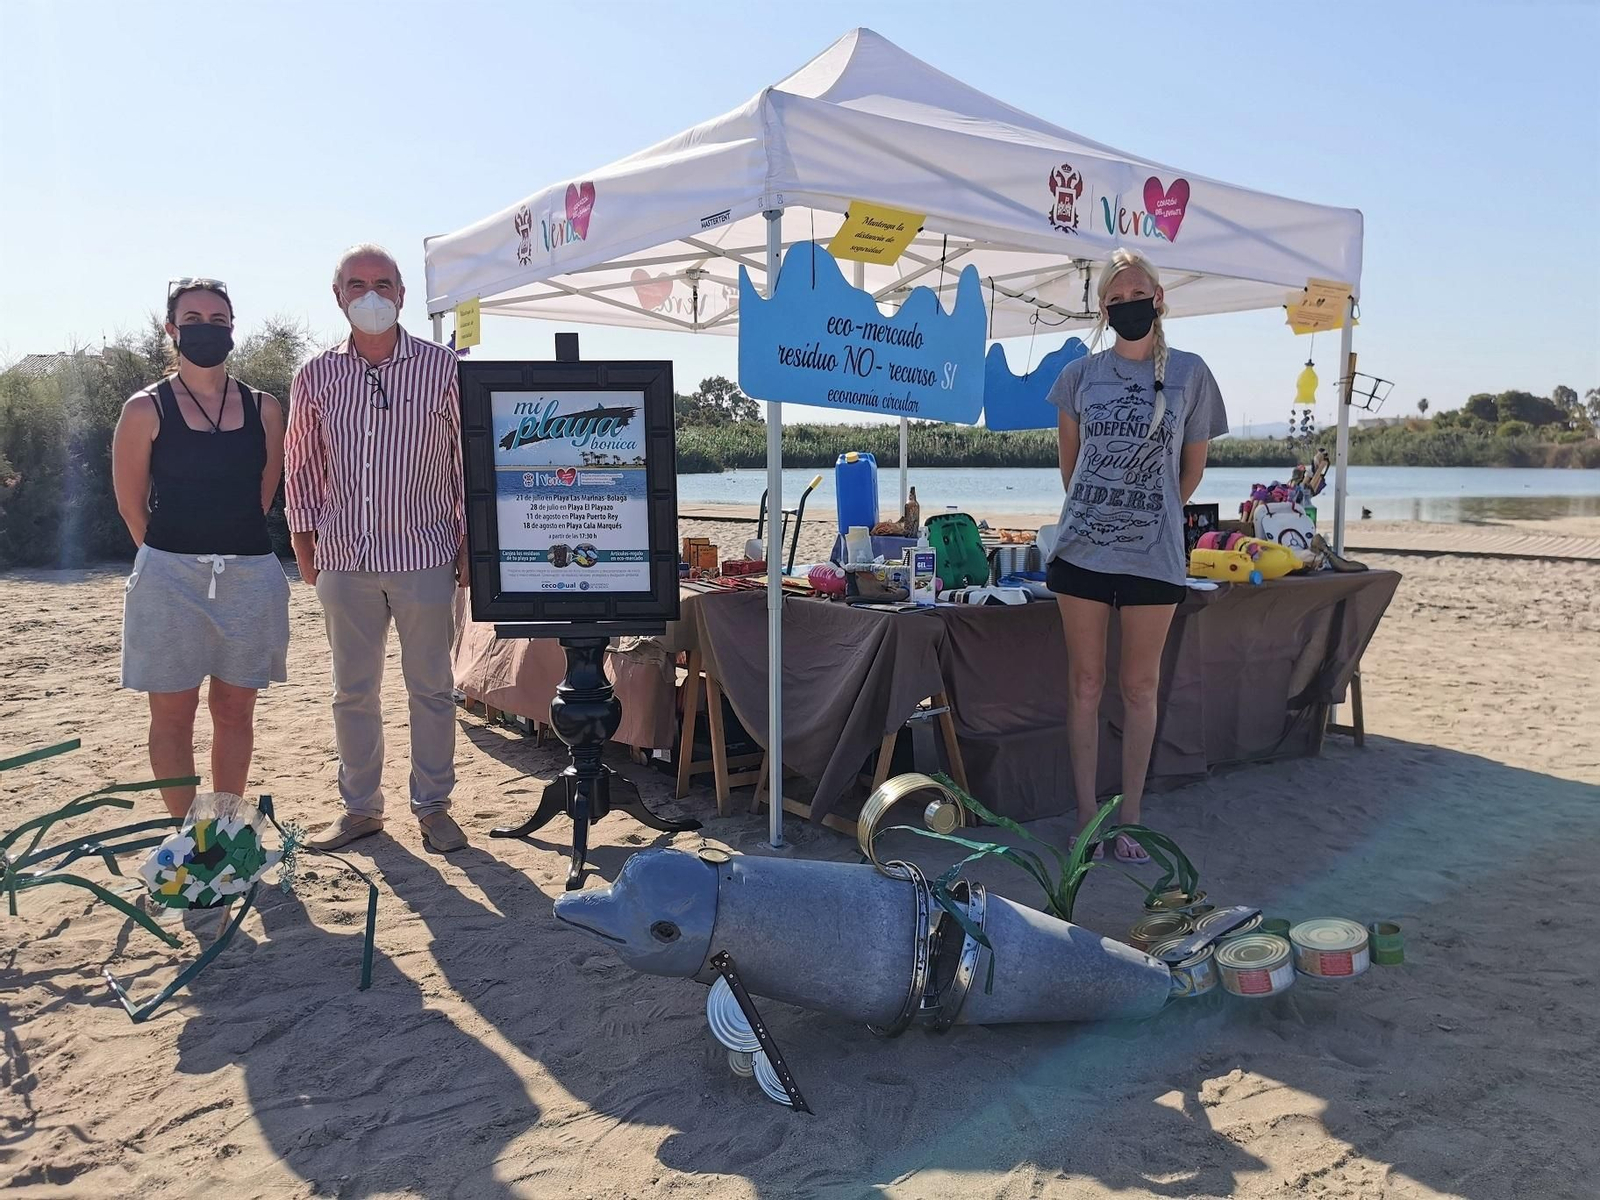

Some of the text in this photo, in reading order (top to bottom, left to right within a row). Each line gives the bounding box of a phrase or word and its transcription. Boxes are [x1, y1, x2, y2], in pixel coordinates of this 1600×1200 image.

[700, 212, 731, 229] MASTERTENT
[861, 215, 904, 231] Mantenga la
[1100, 194, 1168, 240] Vera
[542, 219, 580, 252] Vera
[854, 231, 885, 242] distancia
[849, 245, 884, 254] seguridad
[827, 316, 924, 350] eco-mercado
[778, 341, 838, 372] residuo
[889, 362, 937, 387] recurso
[827, 388, 919, 413] economía circular
[1112, 406, 1144, 423] The
[511, 398, 625, 450] playa
[590, 437, 637, 450] bonica
[1123, 471, 1152, 486] OF
[553, 494, 570, 503] Playa
[1070, 482, 1164, 511] RIDERS
[530, 503, 538, 511] 28
[538, 503, 546, 511] de
[546, 503, 559, 512] julio
[567, 503, 584, 512] Playa
[584, 503, 590, 511] El
[591, 503, 614, 512] Playazo
[526, 512, 533, 520] 11
[534, 512, 542, 520] de
[542, 513, 561, 521] agosto
[569, 512, 585, 521] Playa
[586, 512, 607, 520] Puerto
[607, 512, 619, 521] Rey
[566, 522, 583, 530] Playa
[596, 522, 622, 530] Marqués
